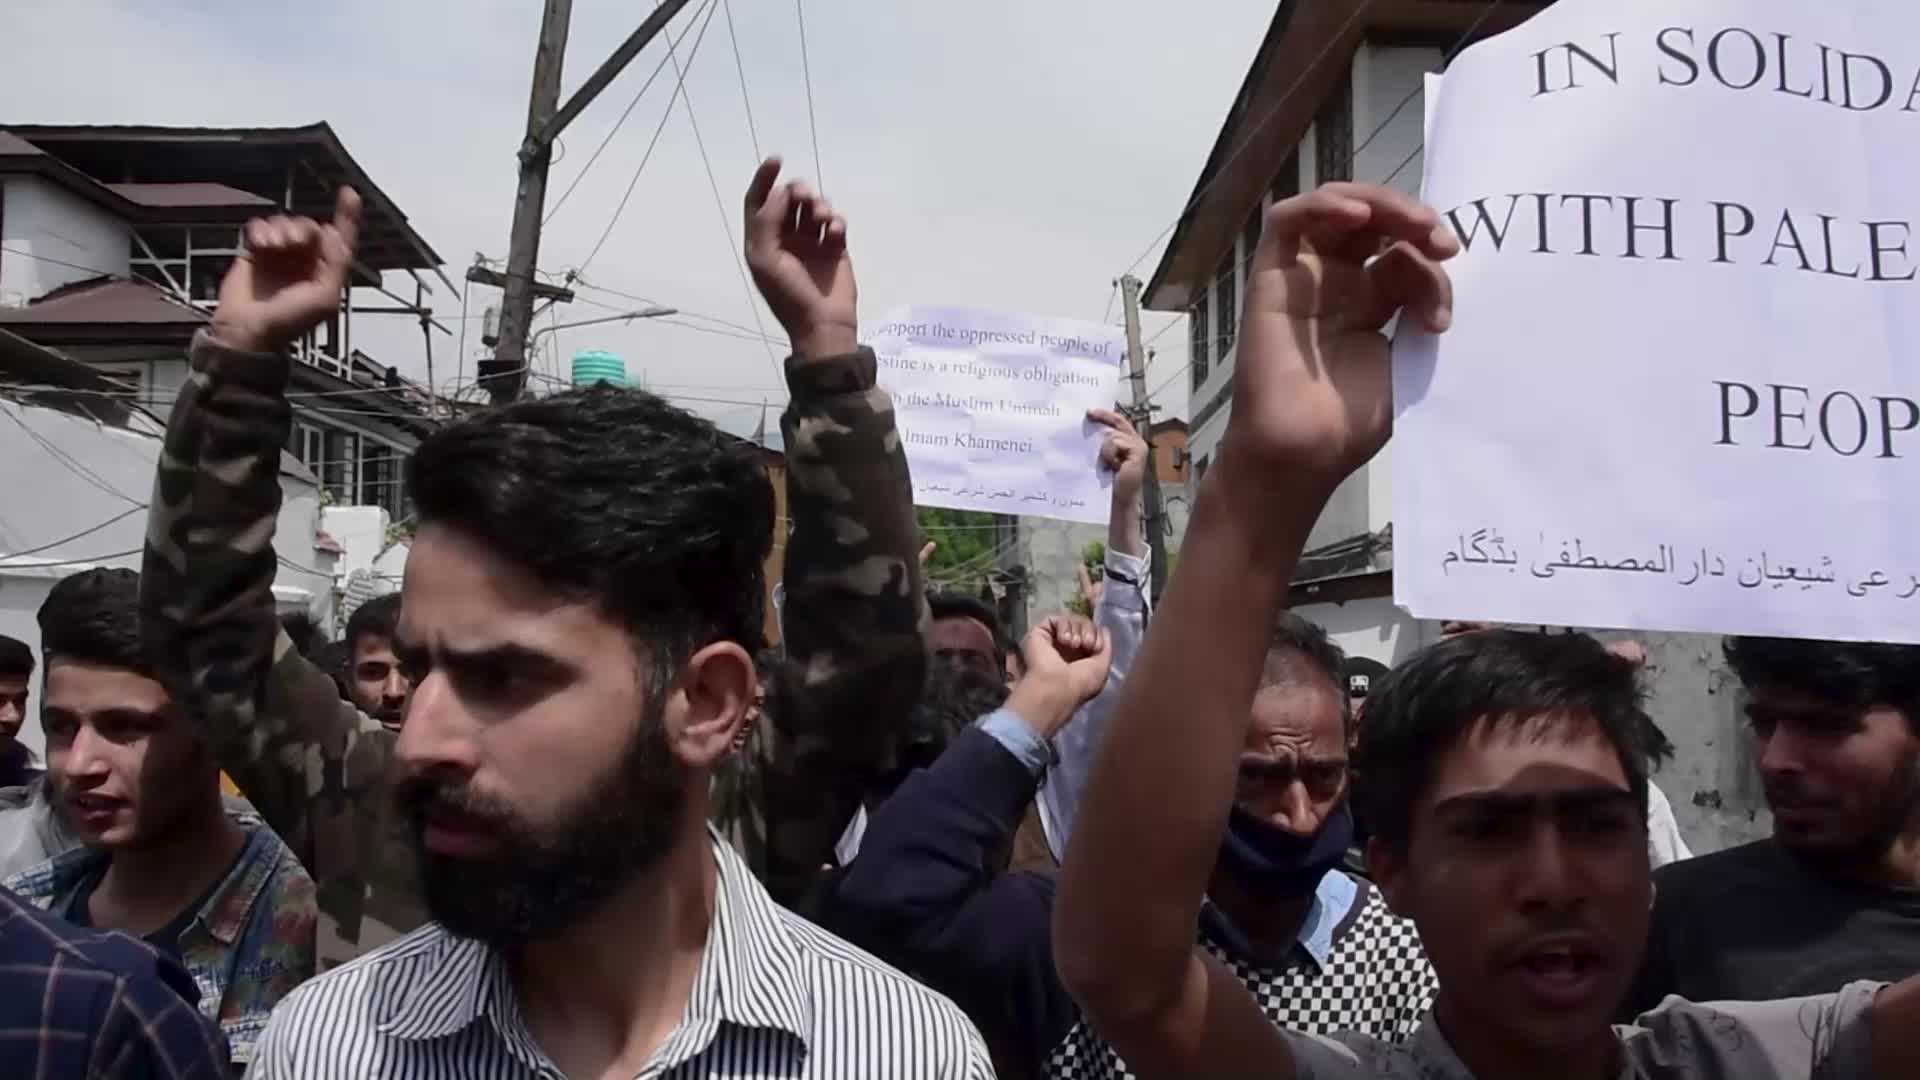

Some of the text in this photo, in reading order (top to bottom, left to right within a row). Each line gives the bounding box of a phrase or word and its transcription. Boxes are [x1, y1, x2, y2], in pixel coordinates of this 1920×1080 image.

[1531, 31, 1622, 98] IN
[1441, 193, 1918, 281] WITH PALE
[873, 322, 1112, 355] pport the oppressed people of
[922, 361, 935, 372] is
[939, 362, 948, 372] a
[953, 361, 1019, 380] religious
[1024, 365, 1099, 387] obligation
[907, 391, 930, 407] the
[935, 391, 993, 411] Muslim
[1711, 380, 1920, 459] PEOP
[905, 428, 1033, 453] Imam Khamenei
[1678, 547, 1725, 586] دار
[1847, 571, 1920, 598] رعی
